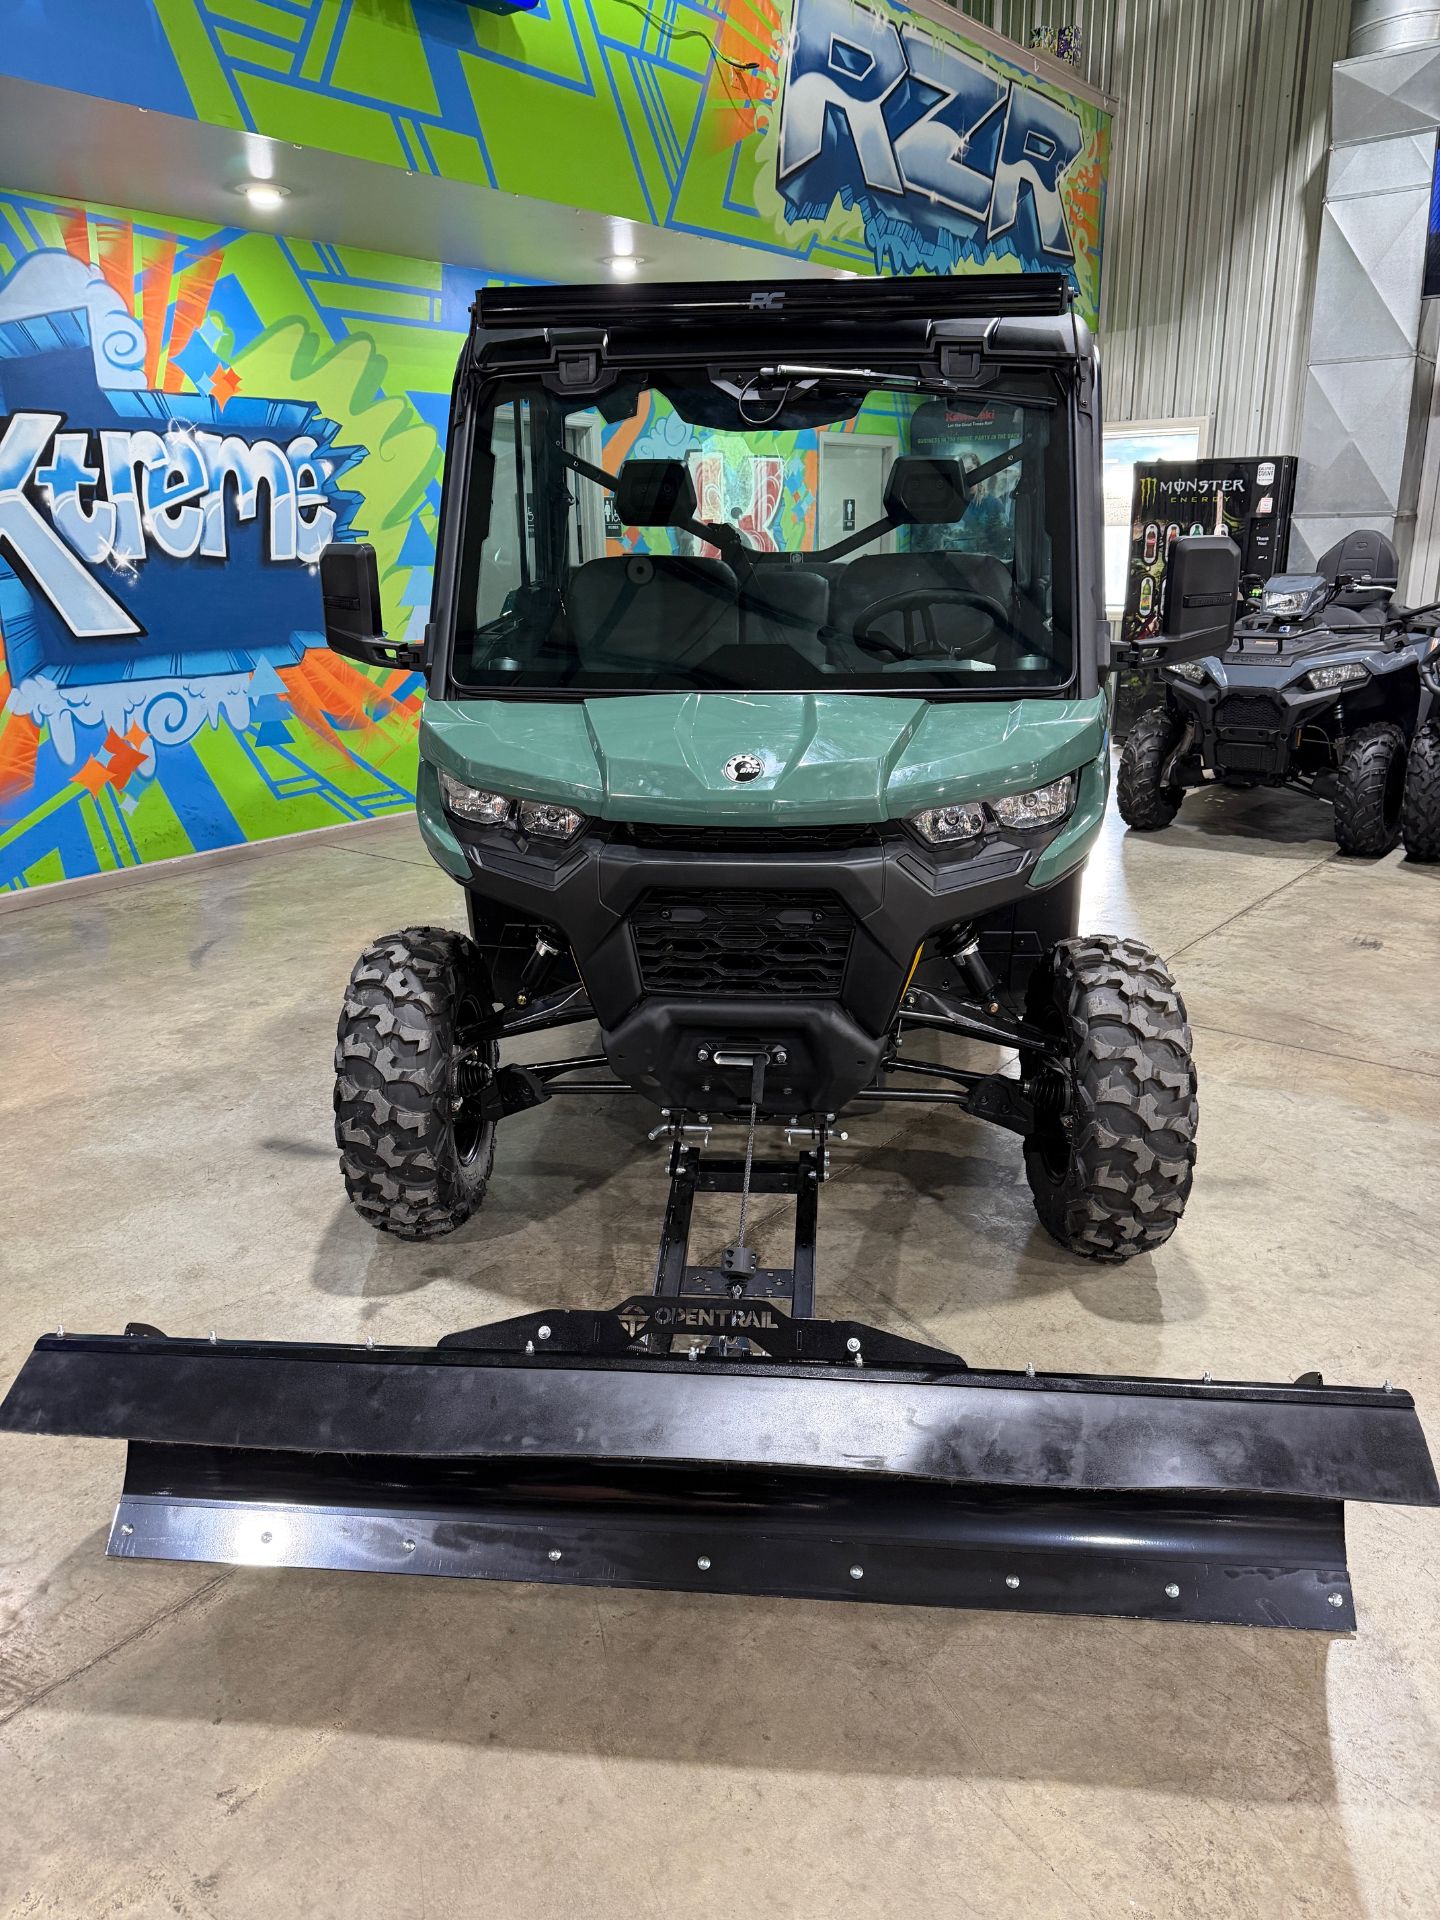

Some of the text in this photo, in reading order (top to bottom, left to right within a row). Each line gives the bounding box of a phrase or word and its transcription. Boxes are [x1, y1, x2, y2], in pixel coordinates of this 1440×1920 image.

[778, 0, 1085, 258] RZR
[749, 291, 786, 310] RC
[1160, 478, 1245, 495] MONSTER
[1232, 655, 1283, 664] POLARIS
[654, 1306, 779, 1329] OPENTRAIL
